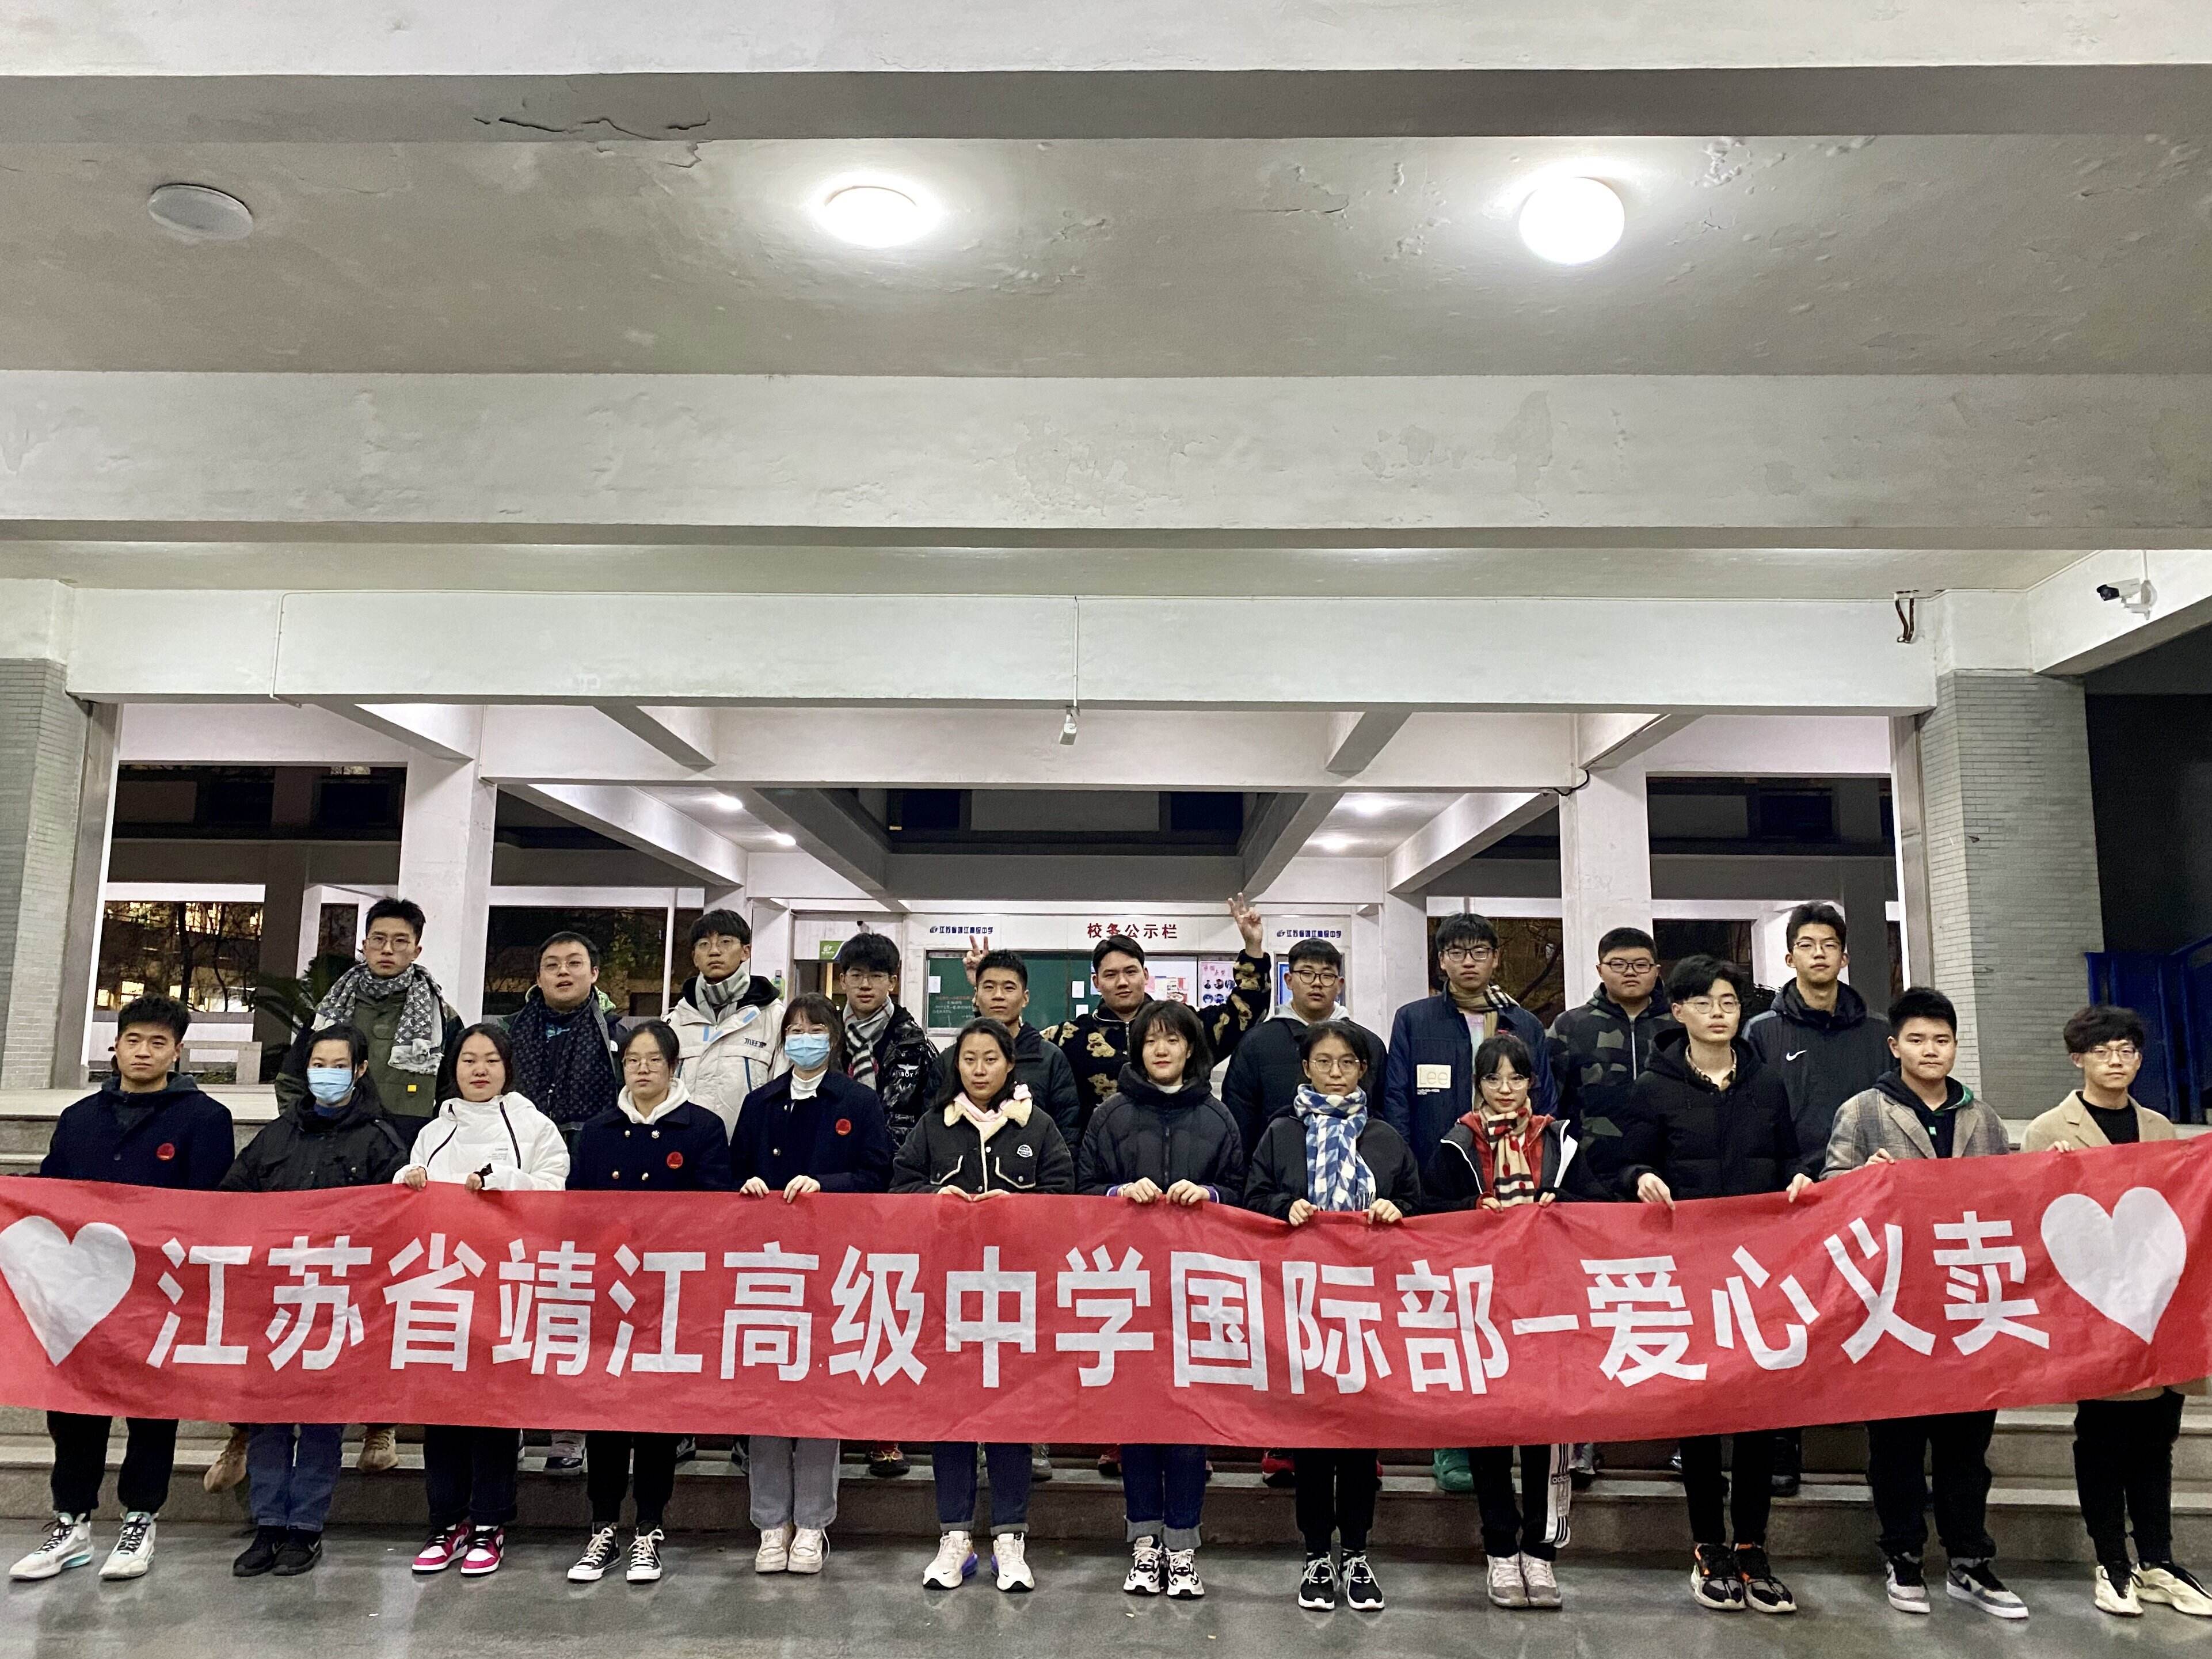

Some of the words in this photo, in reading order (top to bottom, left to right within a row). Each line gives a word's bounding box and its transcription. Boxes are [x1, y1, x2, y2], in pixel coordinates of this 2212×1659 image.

[1087, 923, 1177, 939] 校务公示栏
[1419, 1067, 1448, 1085] Lee
